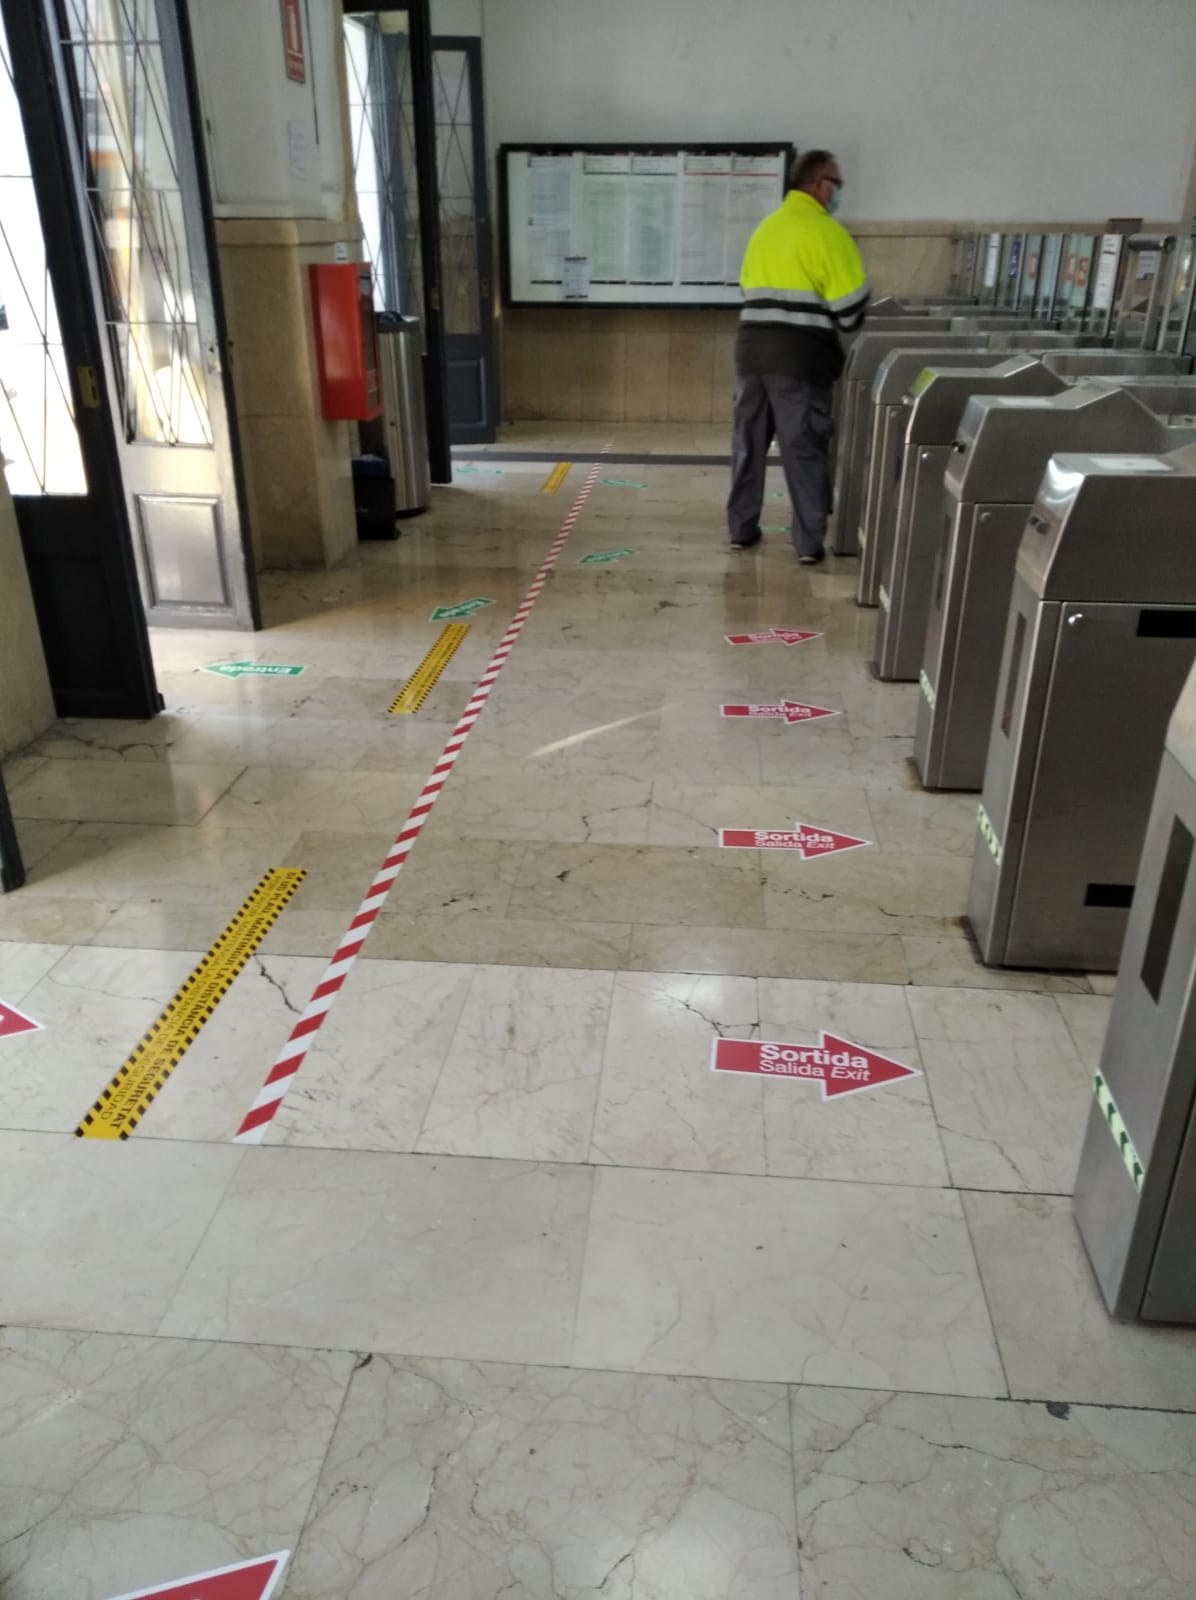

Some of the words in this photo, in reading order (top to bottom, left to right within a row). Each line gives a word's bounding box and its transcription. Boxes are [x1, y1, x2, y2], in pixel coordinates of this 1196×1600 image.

[219, 665, 292, 674] Entrada
[749, 704, 811, 713] Sortida
[754, 831, 833, 843] Sortida
[755, 839, 802, 848] Salida
[806, 841, 835, 849] Exit
[759, 1044, 868, 1068] Sortida
[759, 1060, 825, 1077] Salida
[830, 1066, 871, 1081] Exit
[100, 1051, 157, 1121] SEGURIDAD
[110, 1058, 167, 1130] SEGURETAT
